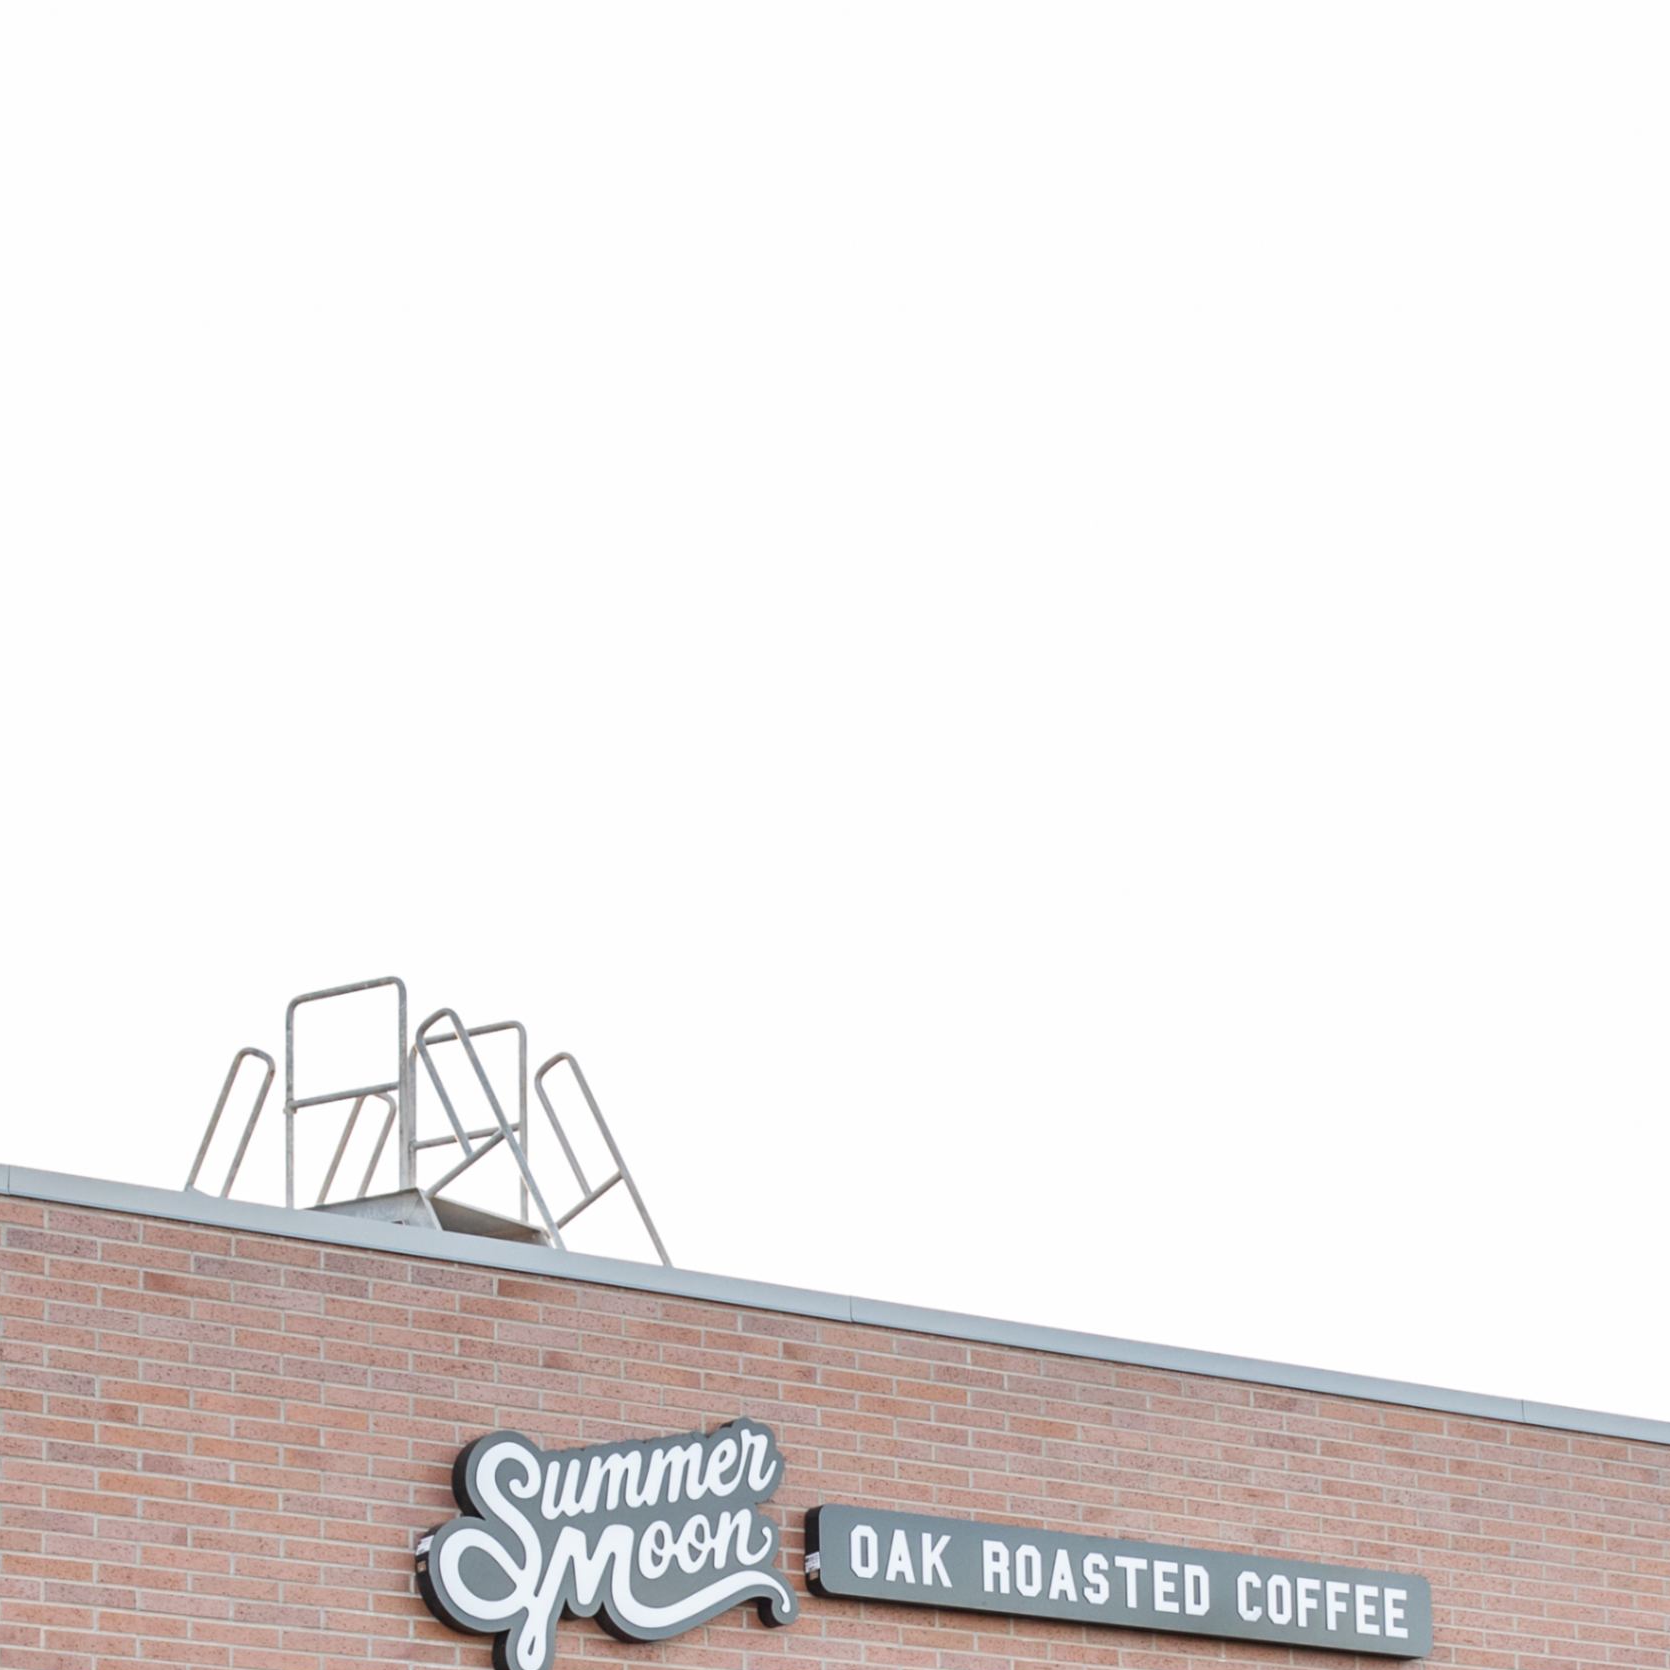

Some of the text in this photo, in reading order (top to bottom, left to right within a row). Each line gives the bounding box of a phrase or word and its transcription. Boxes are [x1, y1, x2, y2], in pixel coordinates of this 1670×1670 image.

[439, 1428, 777, 1620] Summer
[850, 1524, 1409, 1639] OAK ROASTED COFFEE
